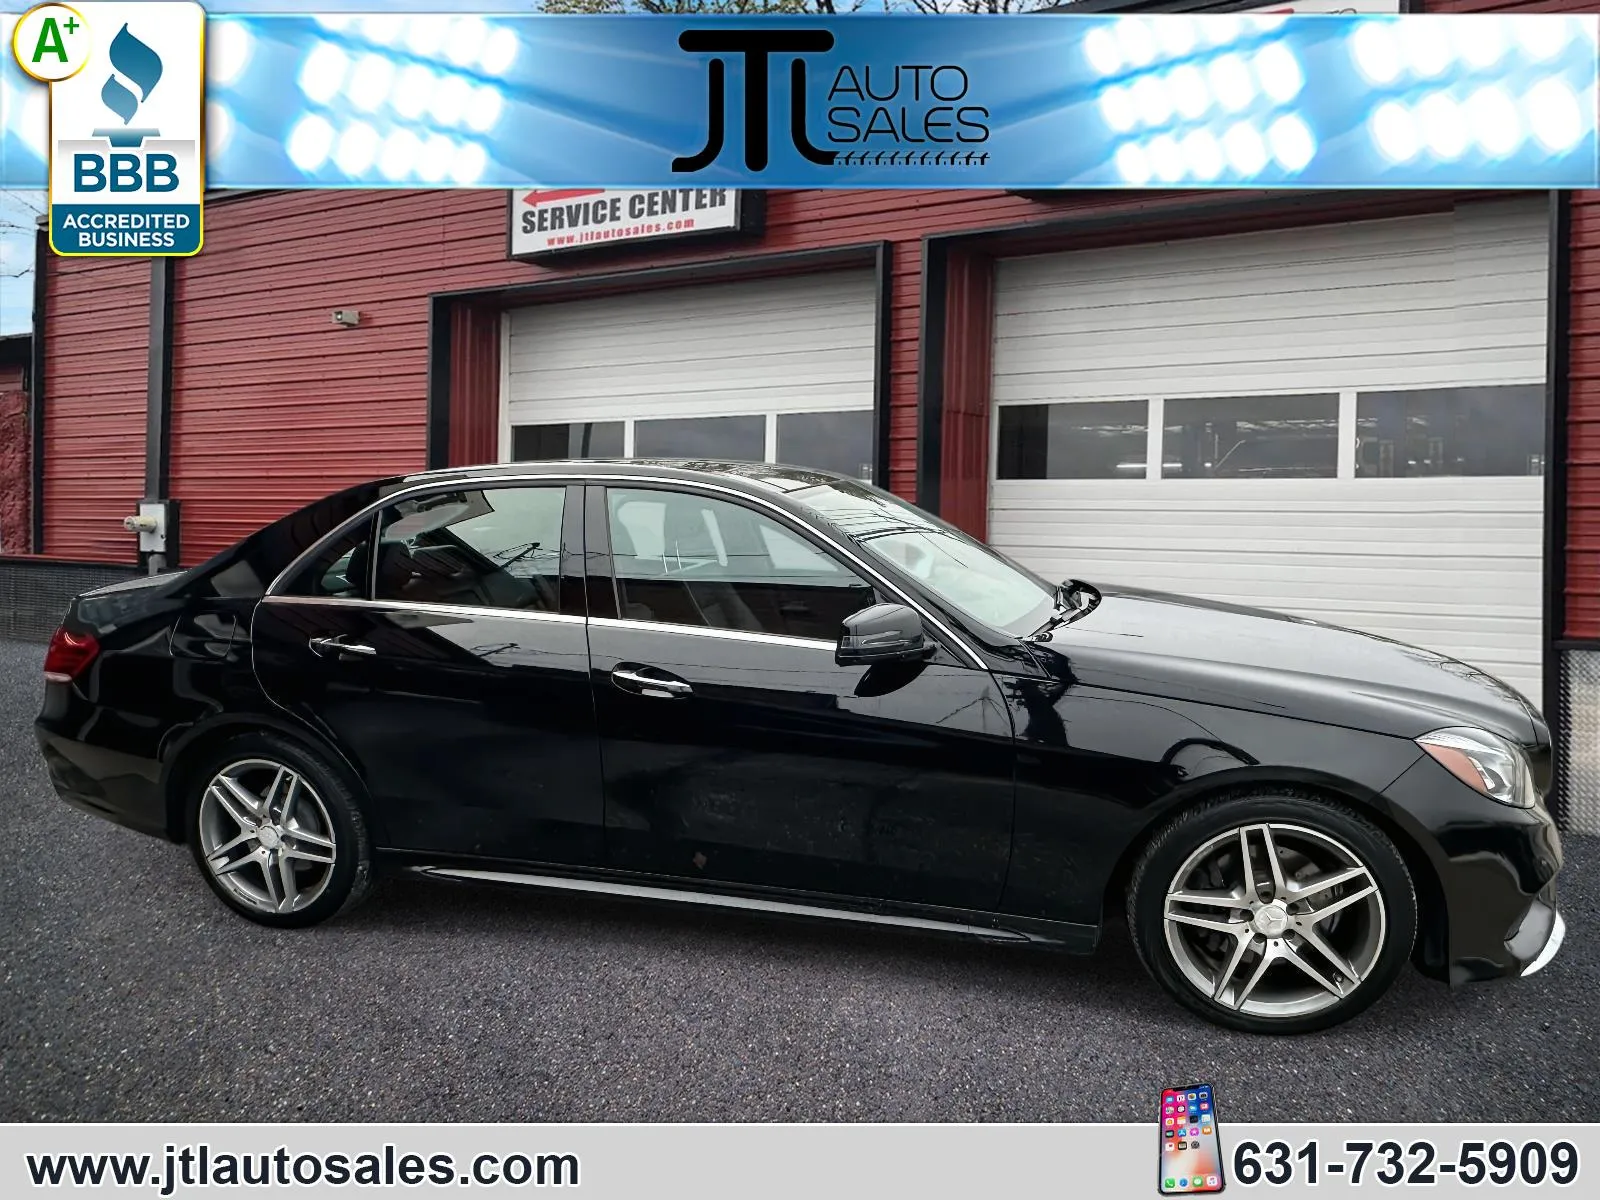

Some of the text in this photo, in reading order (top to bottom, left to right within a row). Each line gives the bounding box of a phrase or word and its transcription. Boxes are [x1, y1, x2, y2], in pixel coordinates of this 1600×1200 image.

[521, 188, 726, 234] SERVICE CENTER
[547, 218, 695, 246] www.jtlautosales.com
